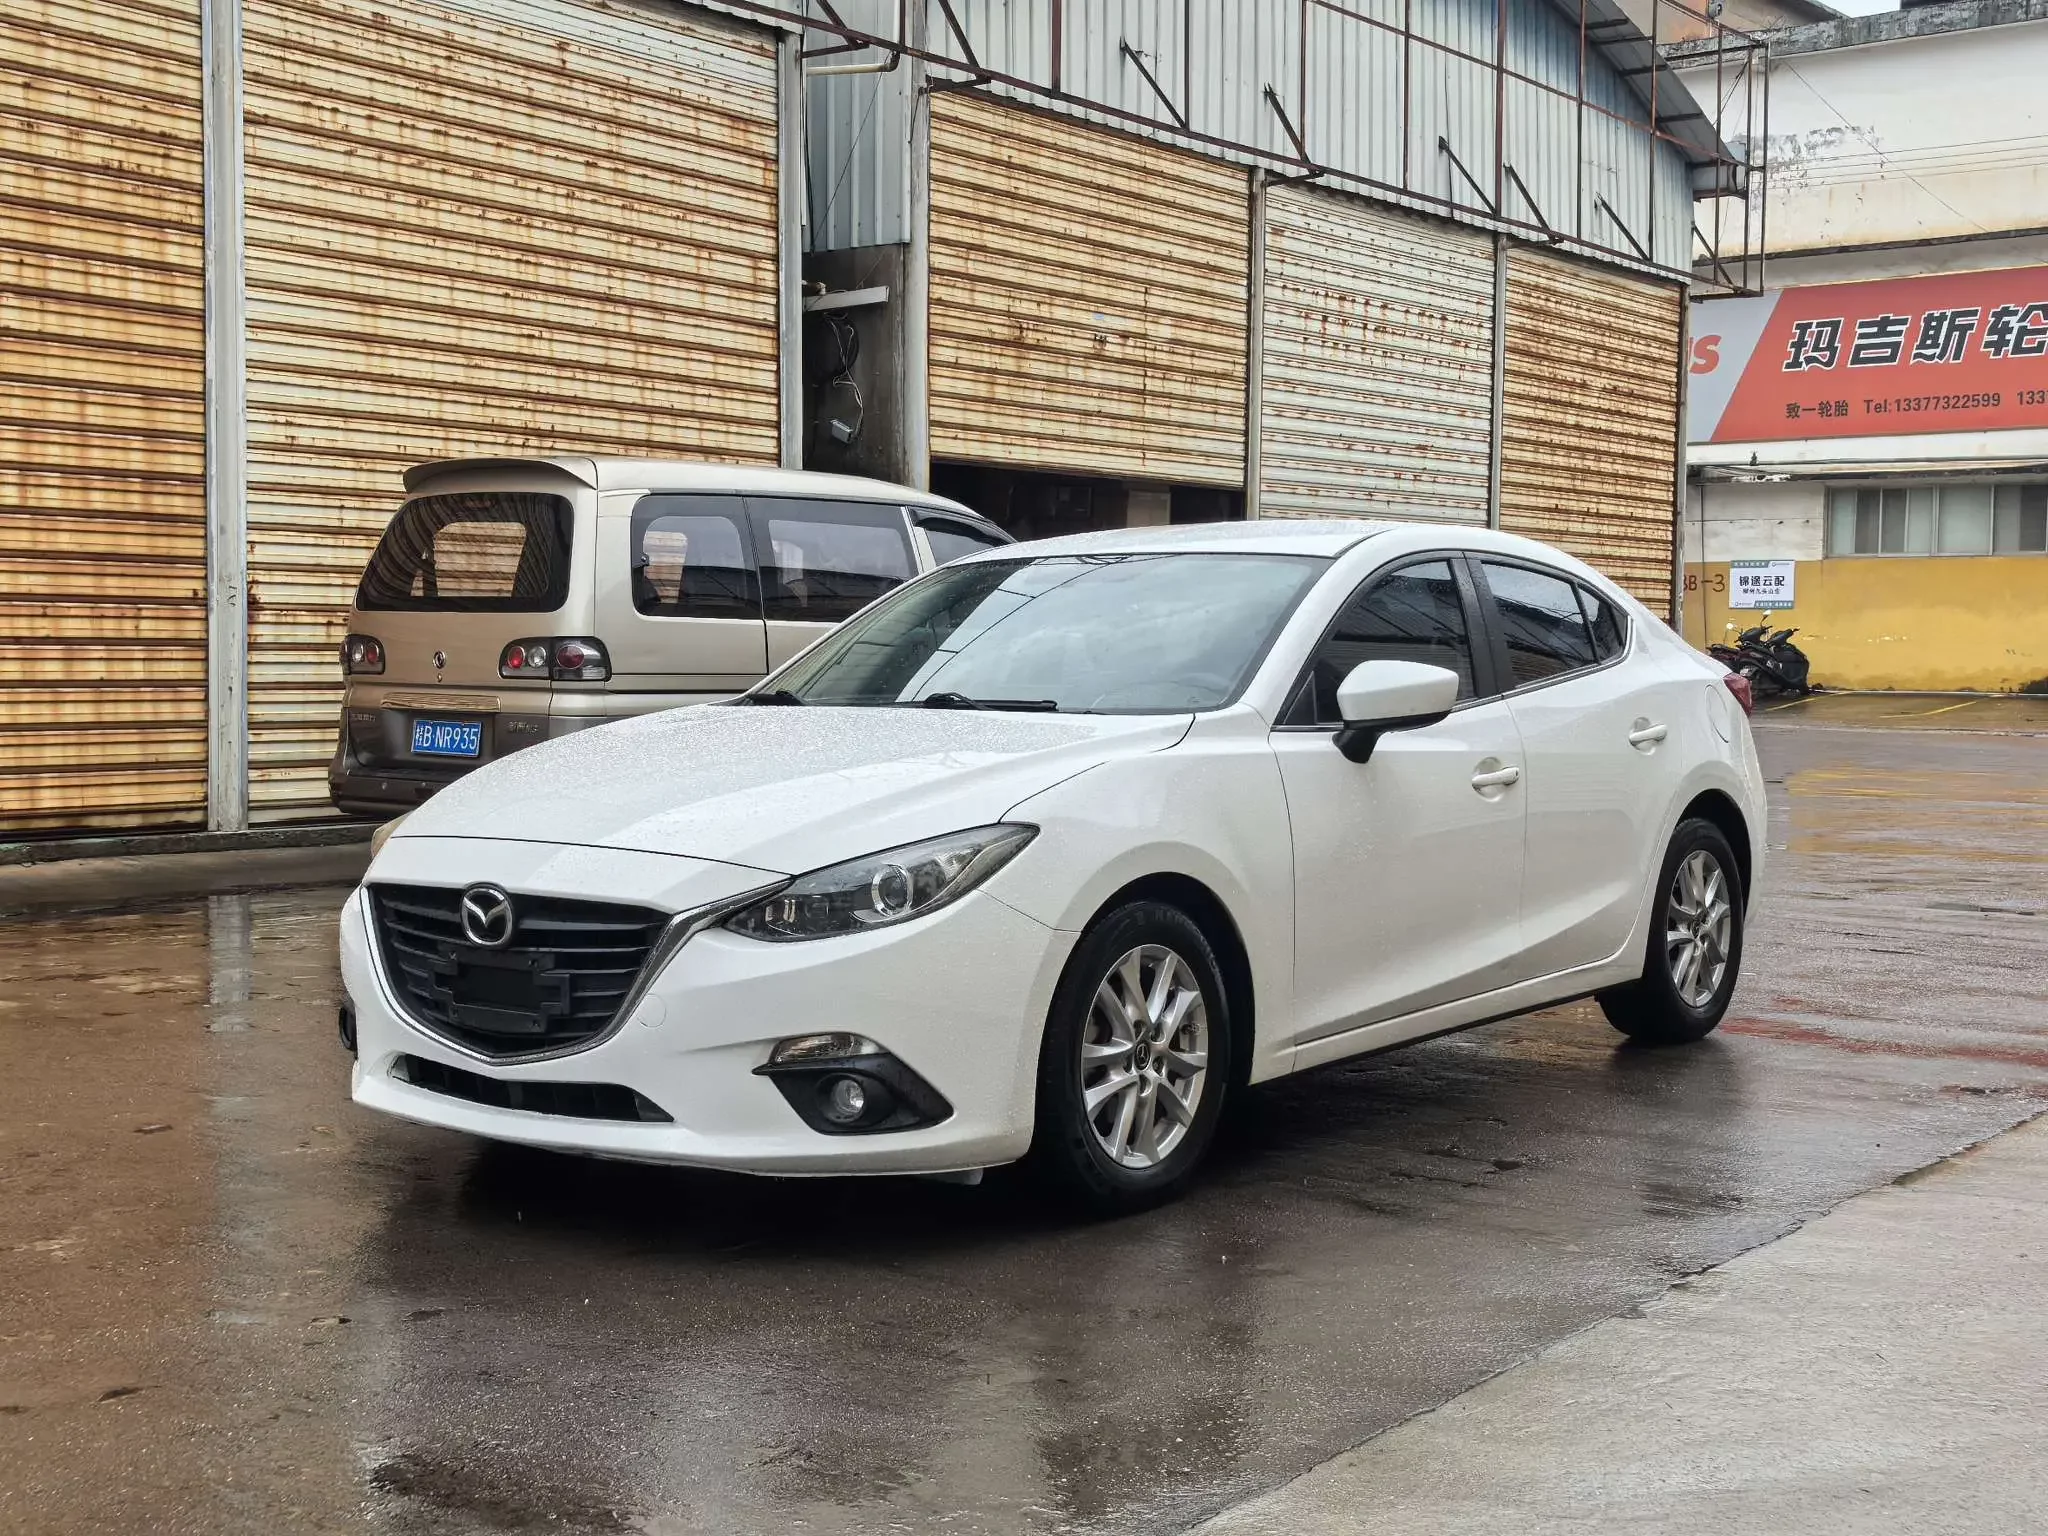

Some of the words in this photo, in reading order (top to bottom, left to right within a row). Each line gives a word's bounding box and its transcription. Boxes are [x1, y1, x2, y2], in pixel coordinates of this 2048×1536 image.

[1688, 334, 1722, 375] S
[1782, 302, 2048, 371] 玛吉斯轮
[1785, 400, 1849, 419] 致一轮胎
[1864, 392, 2001, 414] Tel:13377322599
[2017, 389, 2048, 406] 133
